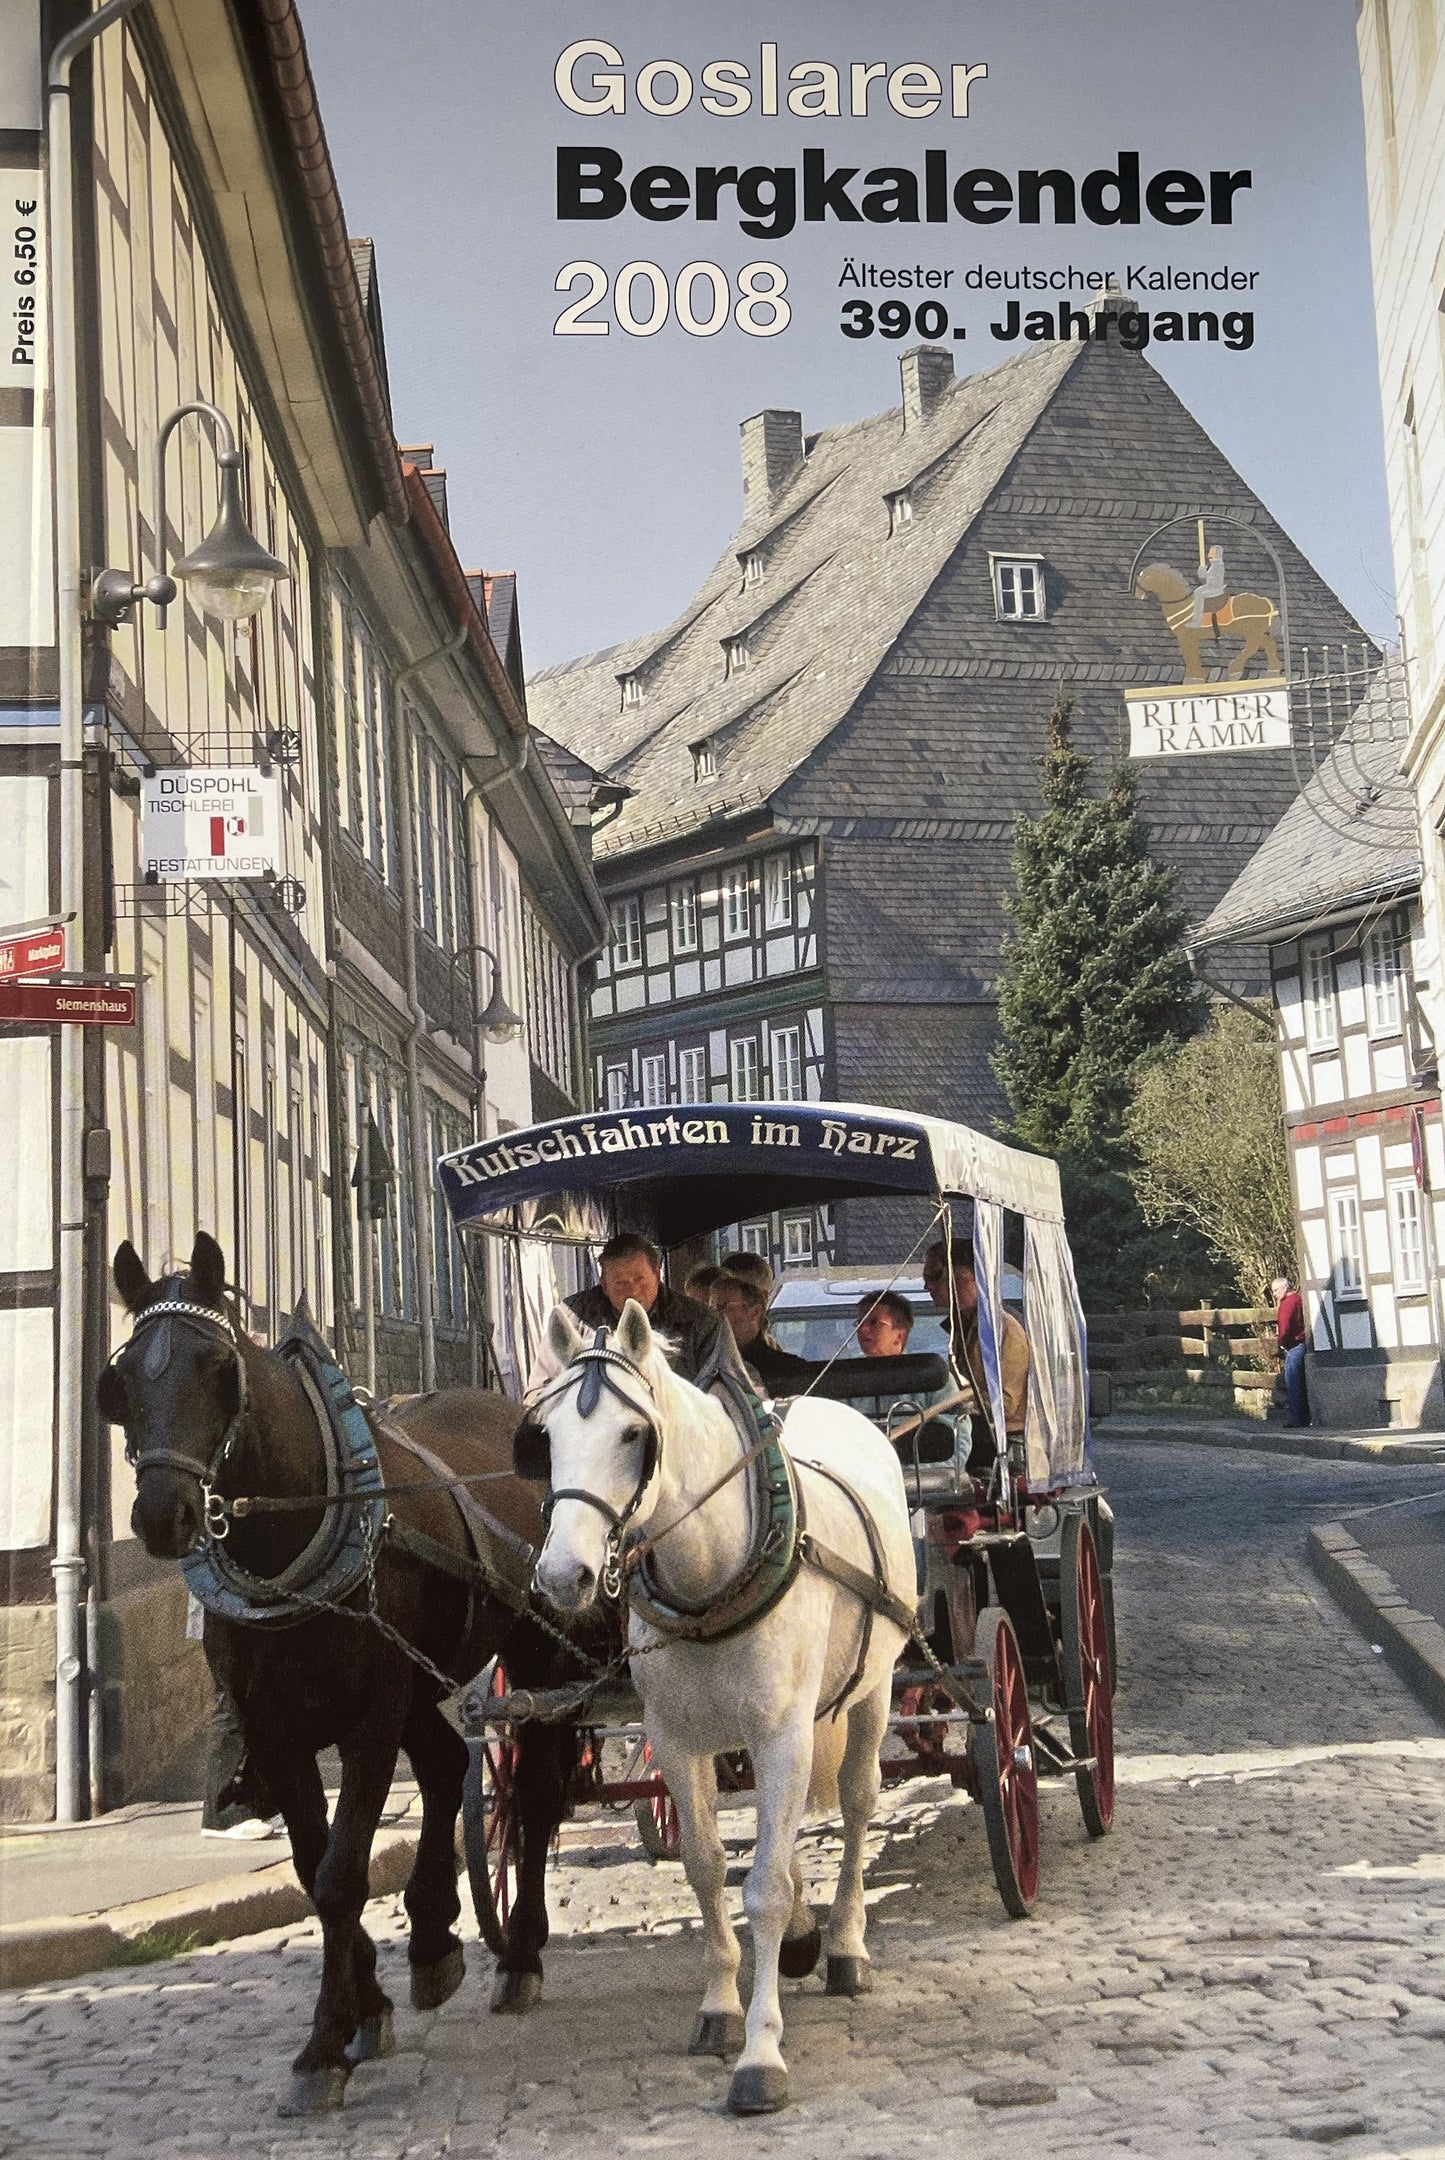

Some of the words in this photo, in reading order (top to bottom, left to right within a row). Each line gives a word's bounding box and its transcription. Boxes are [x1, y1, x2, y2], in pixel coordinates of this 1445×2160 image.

[553, 39, 988, 118] Goslarer
[15, 199, 37, 217] €
[556, 146, 1252, 239] Bergkalender
[14, 226, 37, 286] 6,50
[838, 257, 954, 290] Ältester
[964, 264, 1114, 291] deutscher
[1126, 265, 1260, 292] Kalender
[553, 260, 792, 337] 2008
[12, 296, 35, 365] Preis
[840, 300, 967, 341] 390.
[990, 303, 1255, 351] Jahrgang
[1142, 695, 1277, 728] RITTER
[1158, 721, 1265, 752] RAMM
[160, 775, 257, 795] DÜSPOHL
[147, 799, 234, 813] TISCHLEREI
[147, 857, 273, 872] BESTATTUNGEN
[56, 998, 127, 1013] Siemenshaus
[446, 1115, 729, 1187] Kutschfahrten
[751, 1115, 801, 1147] im
[819, 1120, 919, 1161] Harz
